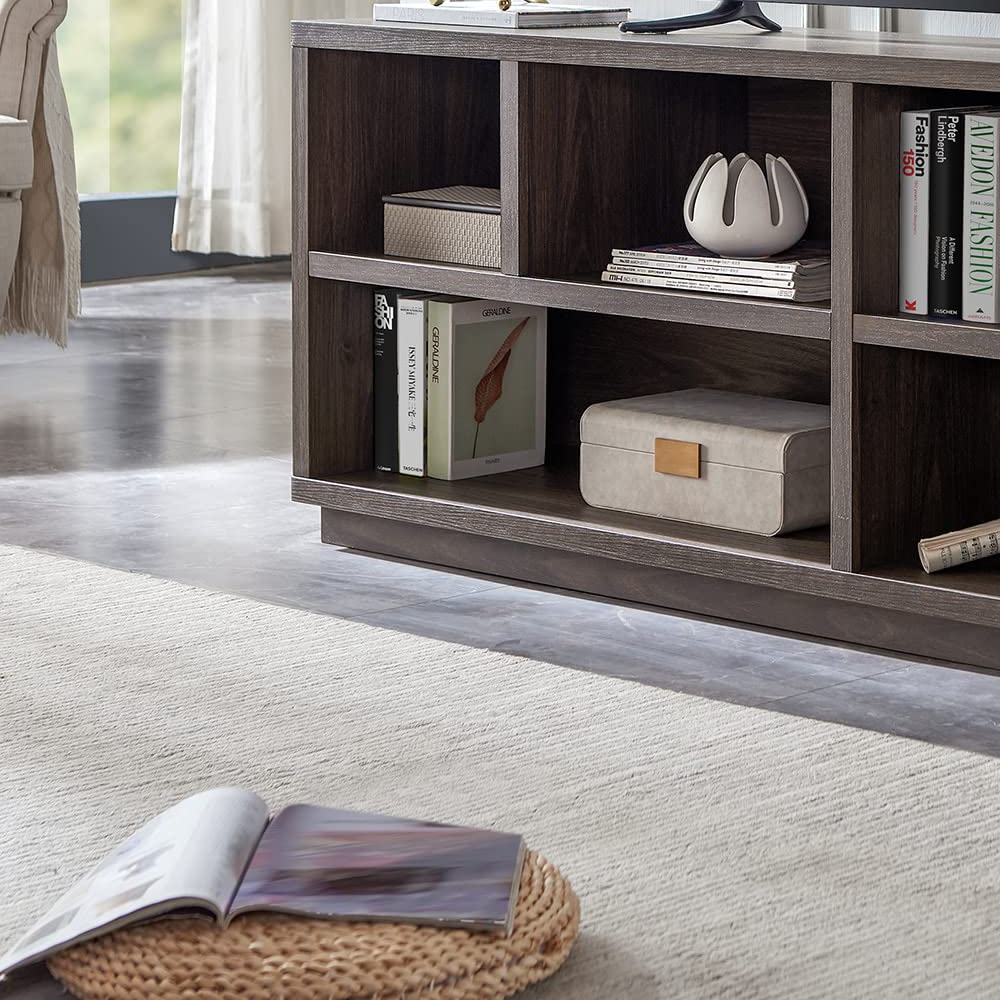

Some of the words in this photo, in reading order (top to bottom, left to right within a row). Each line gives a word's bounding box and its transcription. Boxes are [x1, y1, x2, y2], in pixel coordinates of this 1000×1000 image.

[935, 115, 947, 163] Lindbergh
[947, 115, 959, 142] Peter
[915, 116, 929, 177] Fashion
[970, 117, 994, 197] AVEDON
[902, 148, 915, 177] 150
[933, 236, 941, 268] Photography
[948, 243, 956, 264] Different
[968, 211, 994, 295] FASHION
[481, 307, 511, 317] GERALDINE
[408, 346, 416, 369] ISSEY
[432, 326, 440, 384] GERALDINE
[408, 370, 416, 401] MIYAKE
[402, 465, 423, 473] TASCHEN
